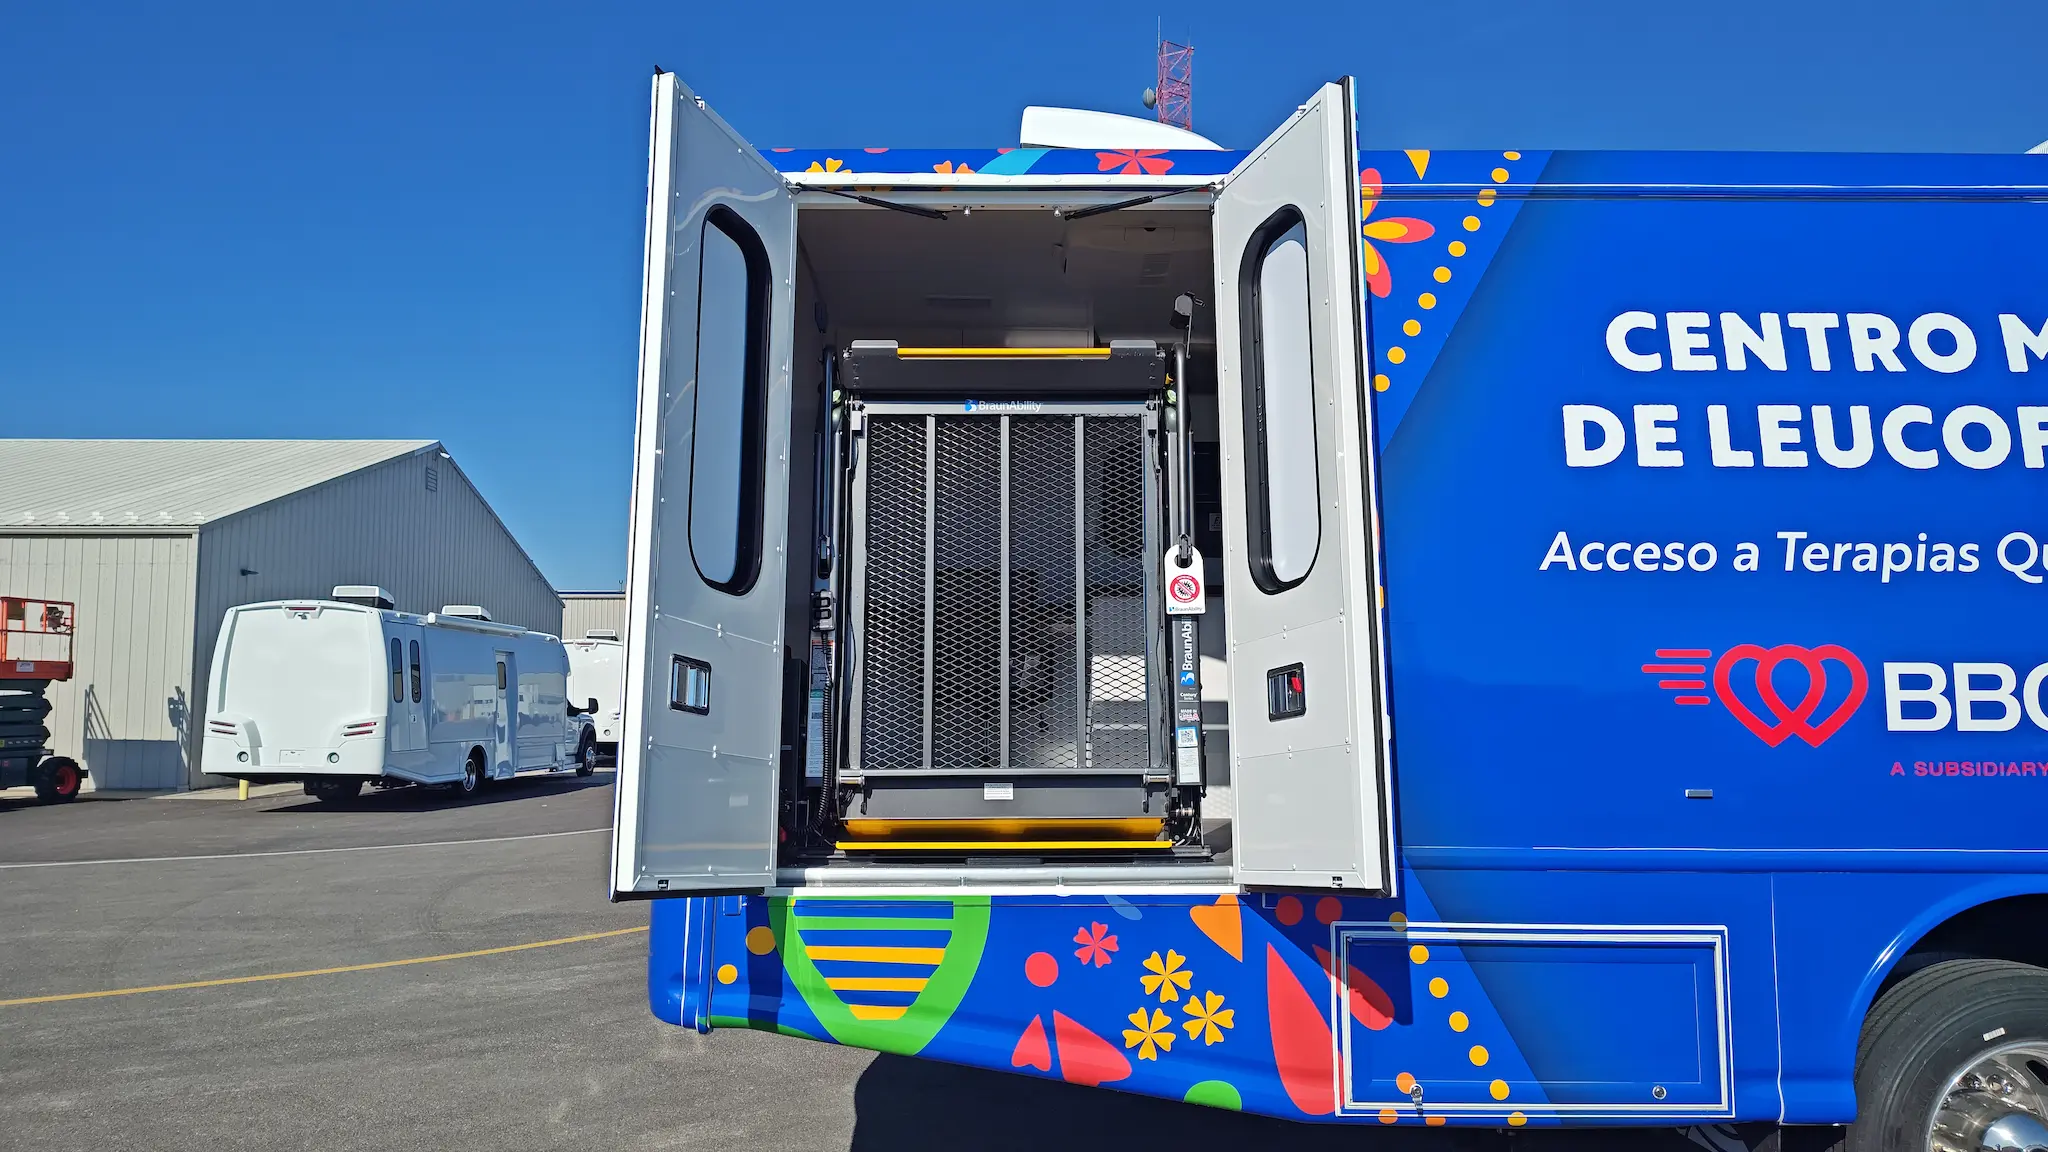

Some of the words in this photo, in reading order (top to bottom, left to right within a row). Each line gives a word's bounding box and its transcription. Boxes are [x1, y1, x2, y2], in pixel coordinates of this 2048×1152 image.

[1605, 310, 1977, 374] CENTRO
[979, 401, 1041, 412] BraunAbility
[1562, 404, 1684, 468] DE
[1539, 531, 1718, 572] Acceso
[1733, 542, 1760, 572] a
[1776, 531, 1980, 583] Terapias
[1996, 531, 2048, 584] Q
[1182, 614, 1193, 671] BraunAbili
[1889, 761, 1905, 777] A
[1914, 761, 2048, 777] SUBSIDIARY
